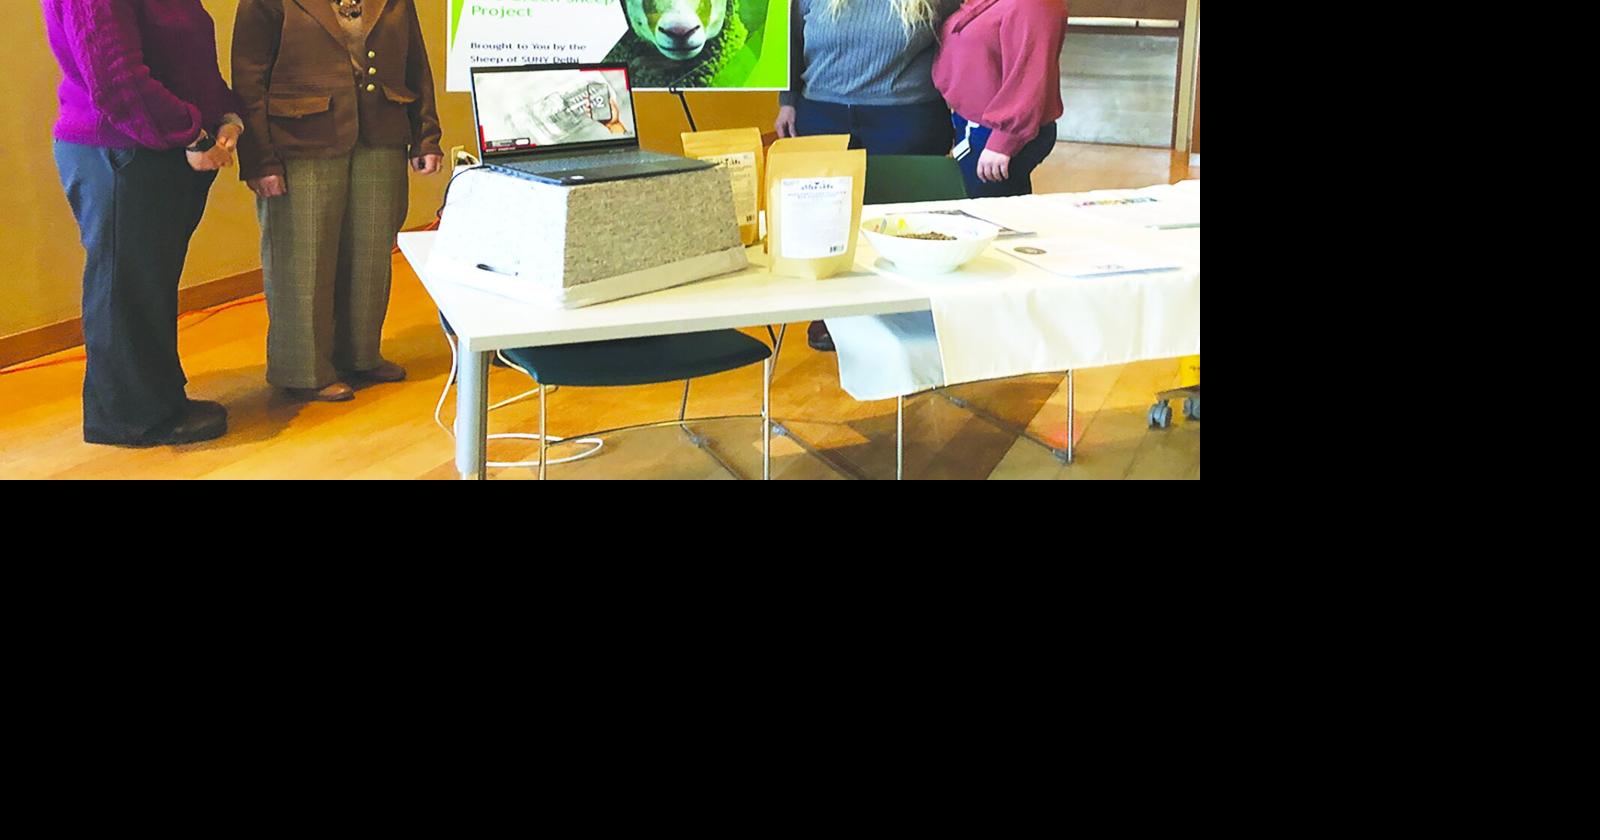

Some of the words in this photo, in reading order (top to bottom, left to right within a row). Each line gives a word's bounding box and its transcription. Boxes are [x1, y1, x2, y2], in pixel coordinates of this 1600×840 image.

[471, 5, 532, 17] Project
[470, 42, 512, 50] Brought
[553, 43, 566, 51] by
